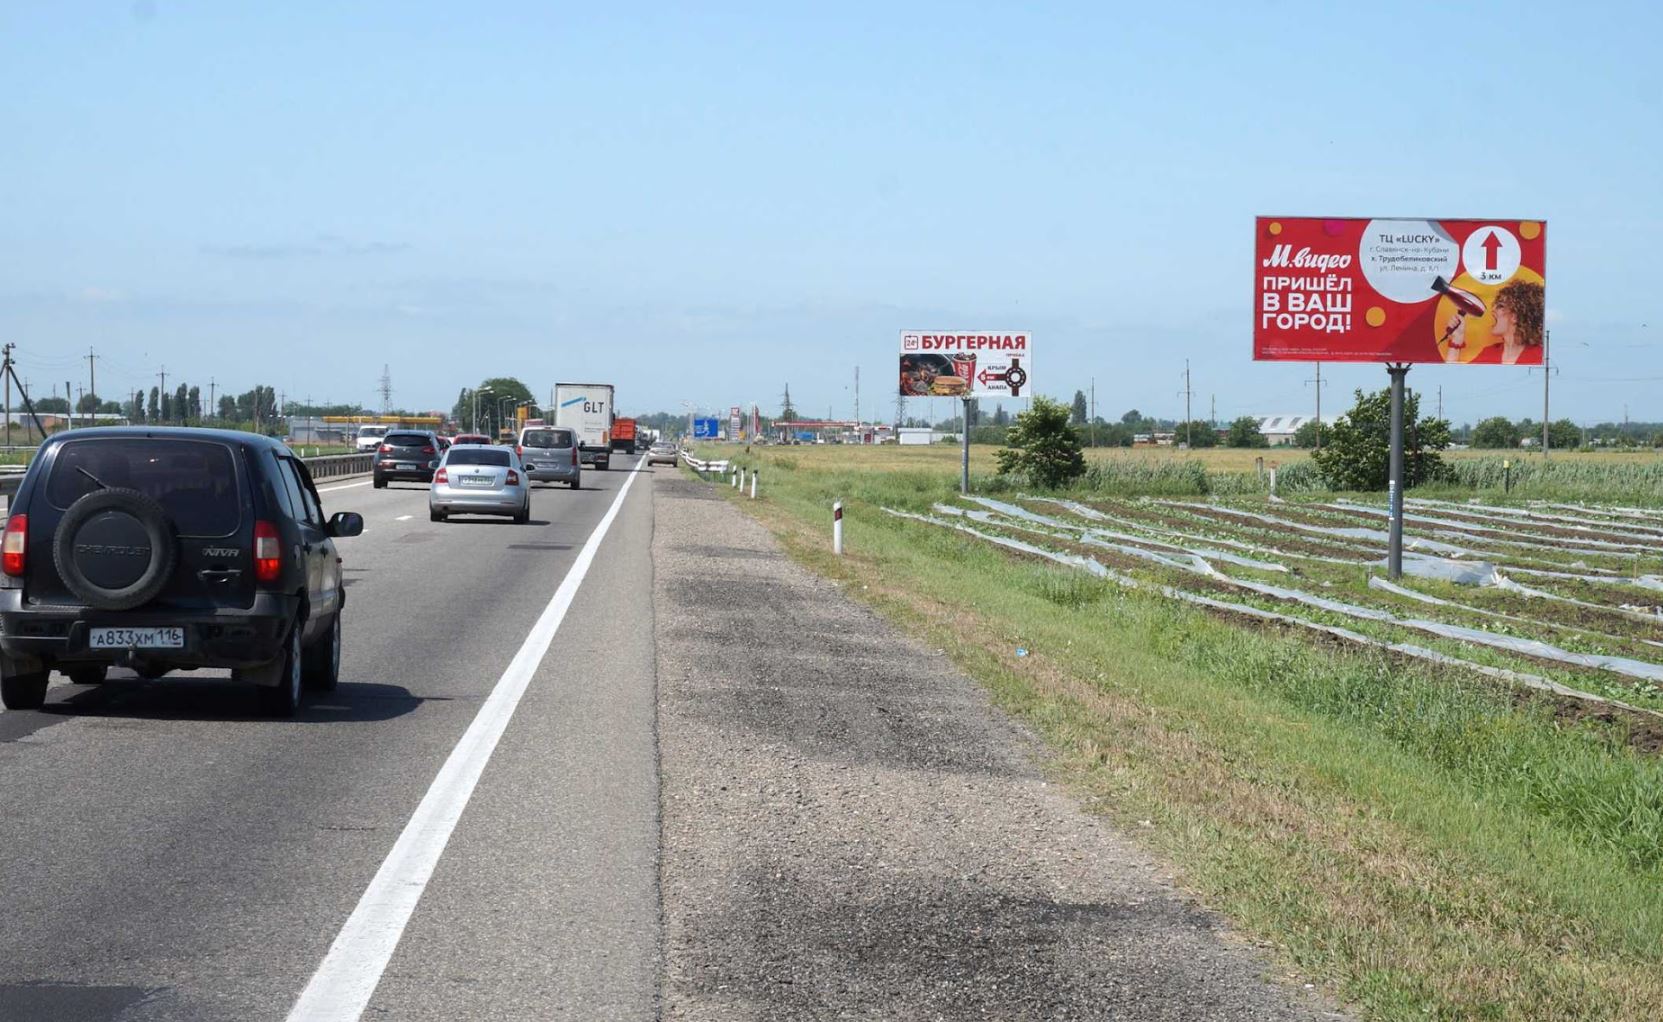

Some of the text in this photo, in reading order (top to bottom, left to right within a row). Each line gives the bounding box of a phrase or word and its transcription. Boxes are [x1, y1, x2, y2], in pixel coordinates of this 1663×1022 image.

[1379, 234, 1394, 244] ТЦ
[1263, 244, 1352, 273] М.видео
[1263, 274, 1352, 292] ПРИШЁЛ
[1263, 292, 1352, 312] В ВАШ
[1262, 313, 1351, 334] ГОРОД!
[921, 335, 1026, 350] БУРГЕРНАЯ
[583, 401, 605, 414] GLT
